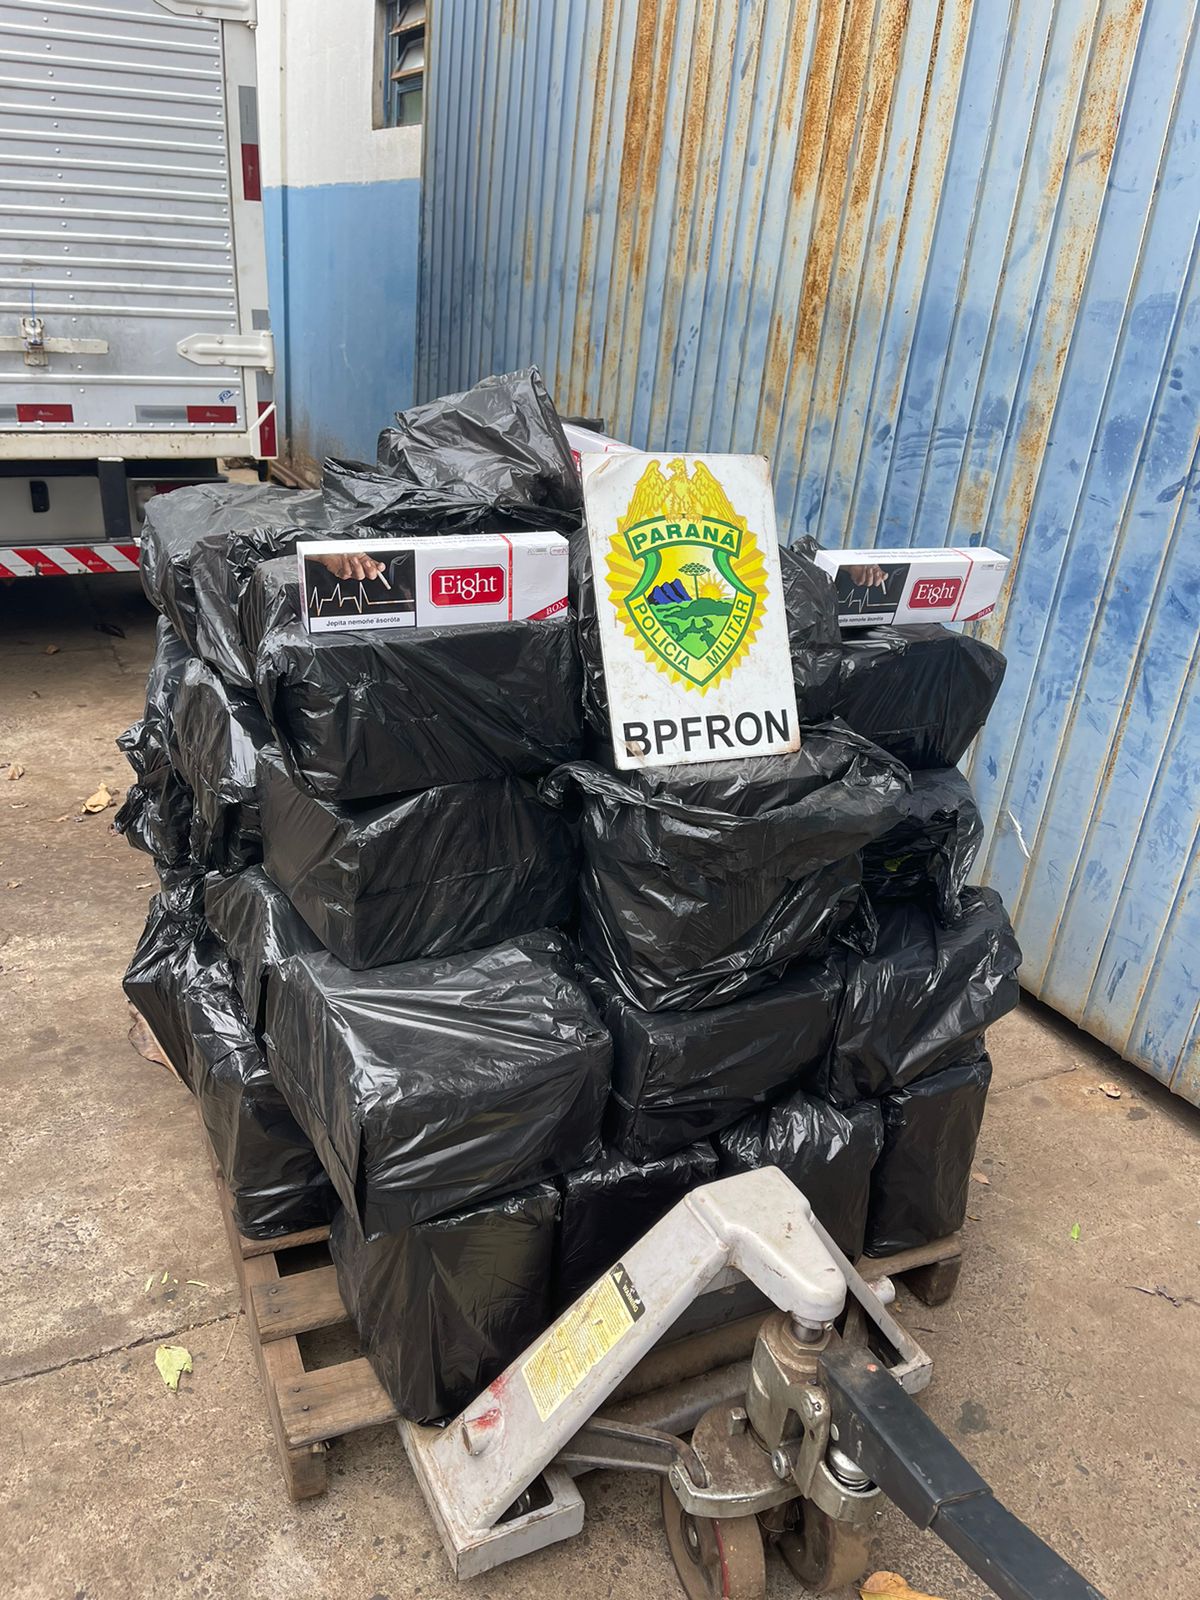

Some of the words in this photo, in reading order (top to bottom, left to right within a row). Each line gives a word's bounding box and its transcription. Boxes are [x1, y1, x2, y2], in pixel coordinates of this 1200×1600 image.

[633, 523, 736, 550] PARANÁ
[439, 573, 497, 601] Eight
[914, 582, 956, 605] Eight
[545, 600, 565, 615] BOX
[633, 602, 691, 671] POLÍCIA
[706, 600, 751, 670] MILITAR
[623, 709, 790, 758] BPFRON
